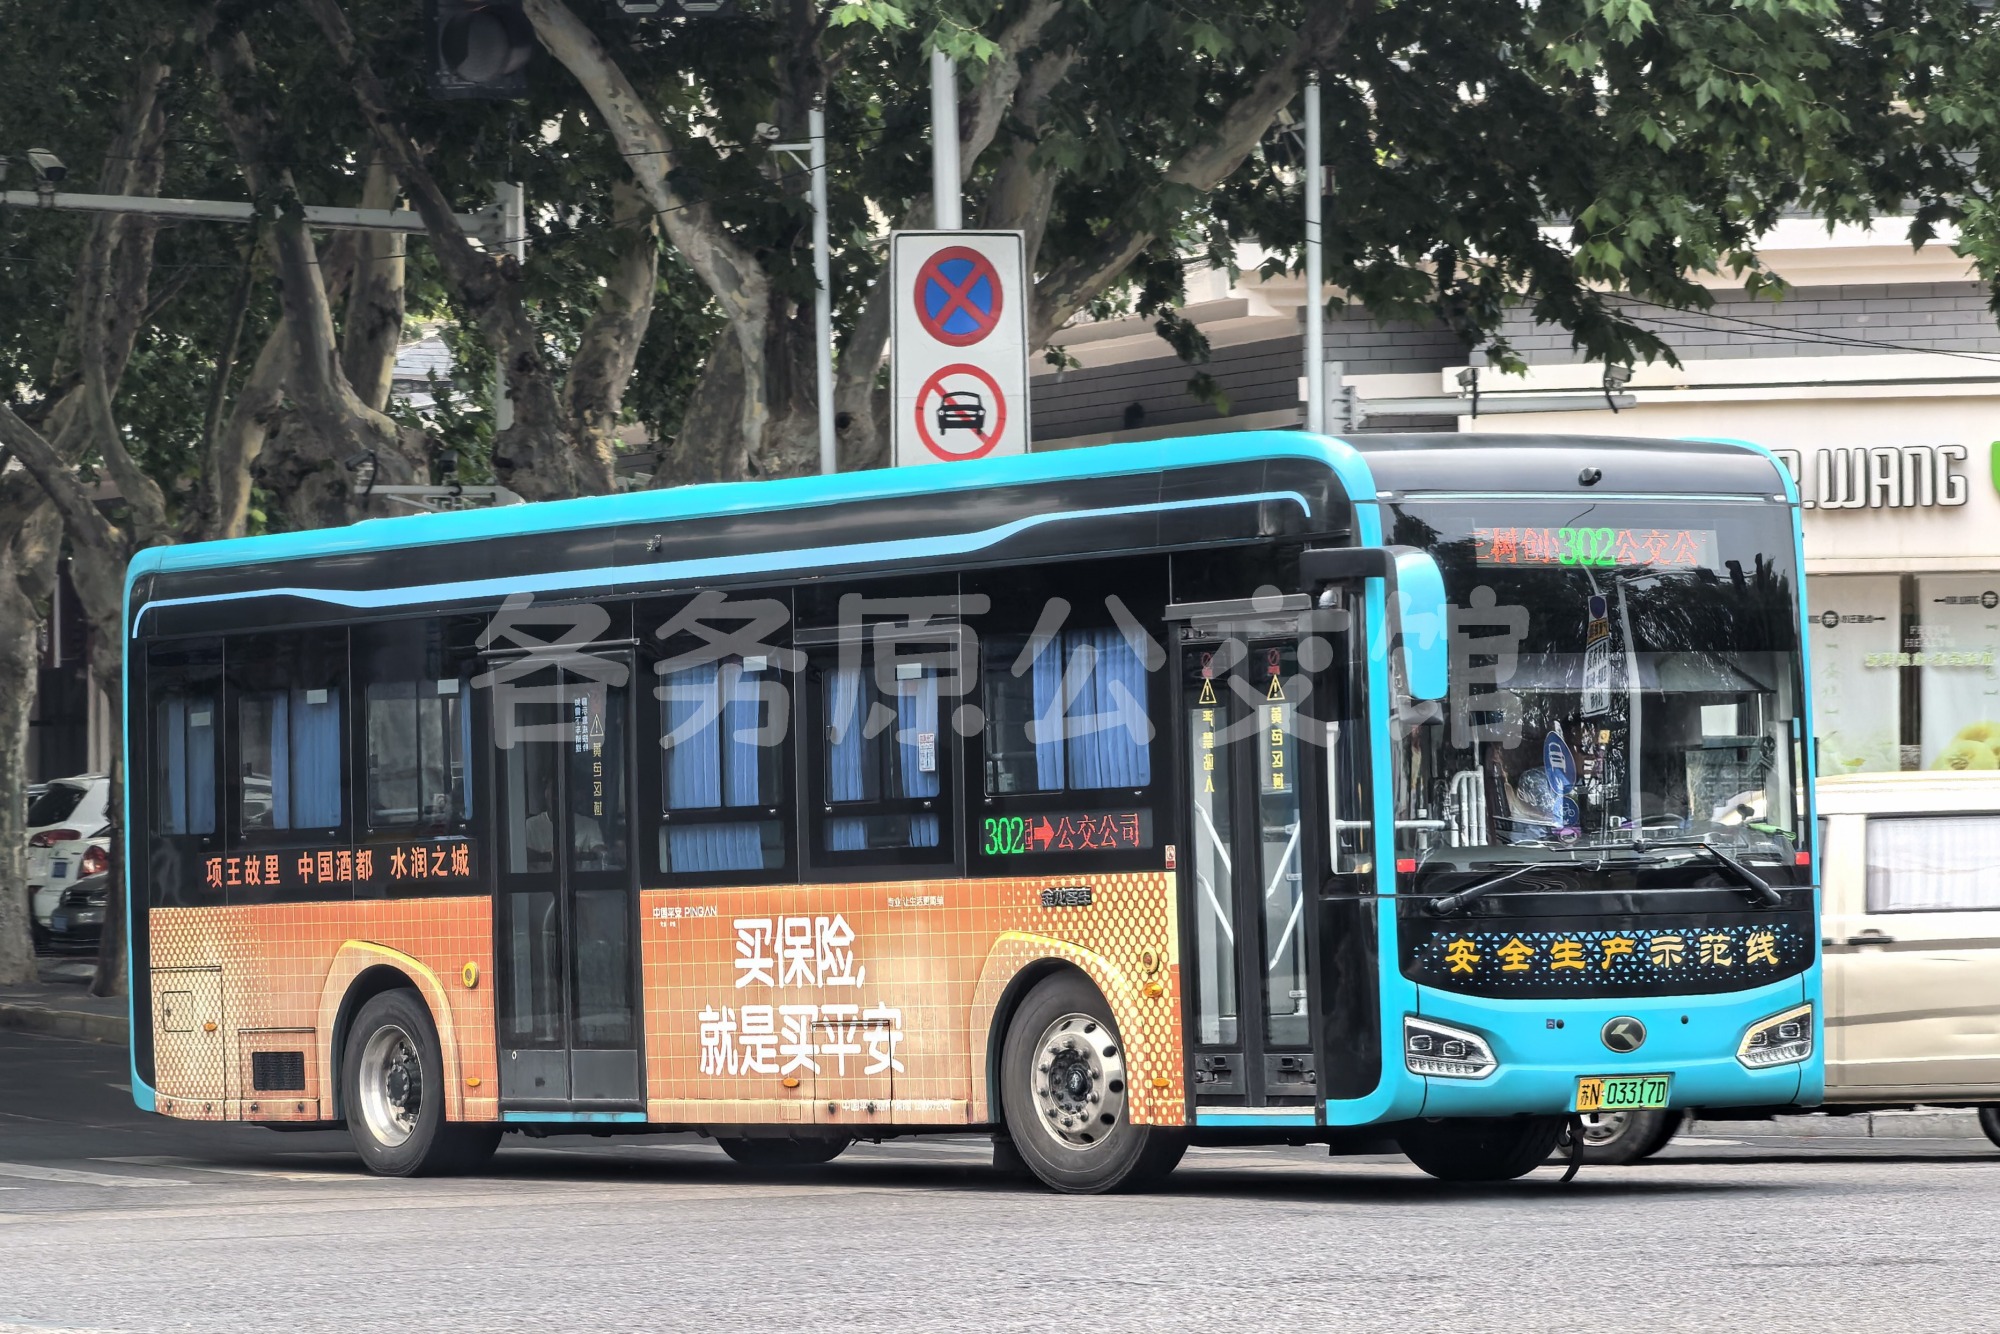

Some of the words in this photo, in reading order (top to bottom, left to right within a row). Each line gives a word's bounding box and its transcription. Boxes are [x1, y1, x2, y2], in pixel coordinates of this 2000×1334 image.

[1559, 527, 1616, 565] 302
[1616, 529, 1707, 564] 公交公
[985, 816, 1024, 855] 302
[1055, 813, 1140, 850] 公交公司
[206, 854, 280, 888] 项王故里
[297, 848, 373, 884] 中国酒都
[390, 843, 470, 880] 水润之城
[653, 907, 683, 918] 中国平安
[1444, 930, 1779, 974] 安全生产示范线
[698, 1001, 905, 1076] 就是买平安
